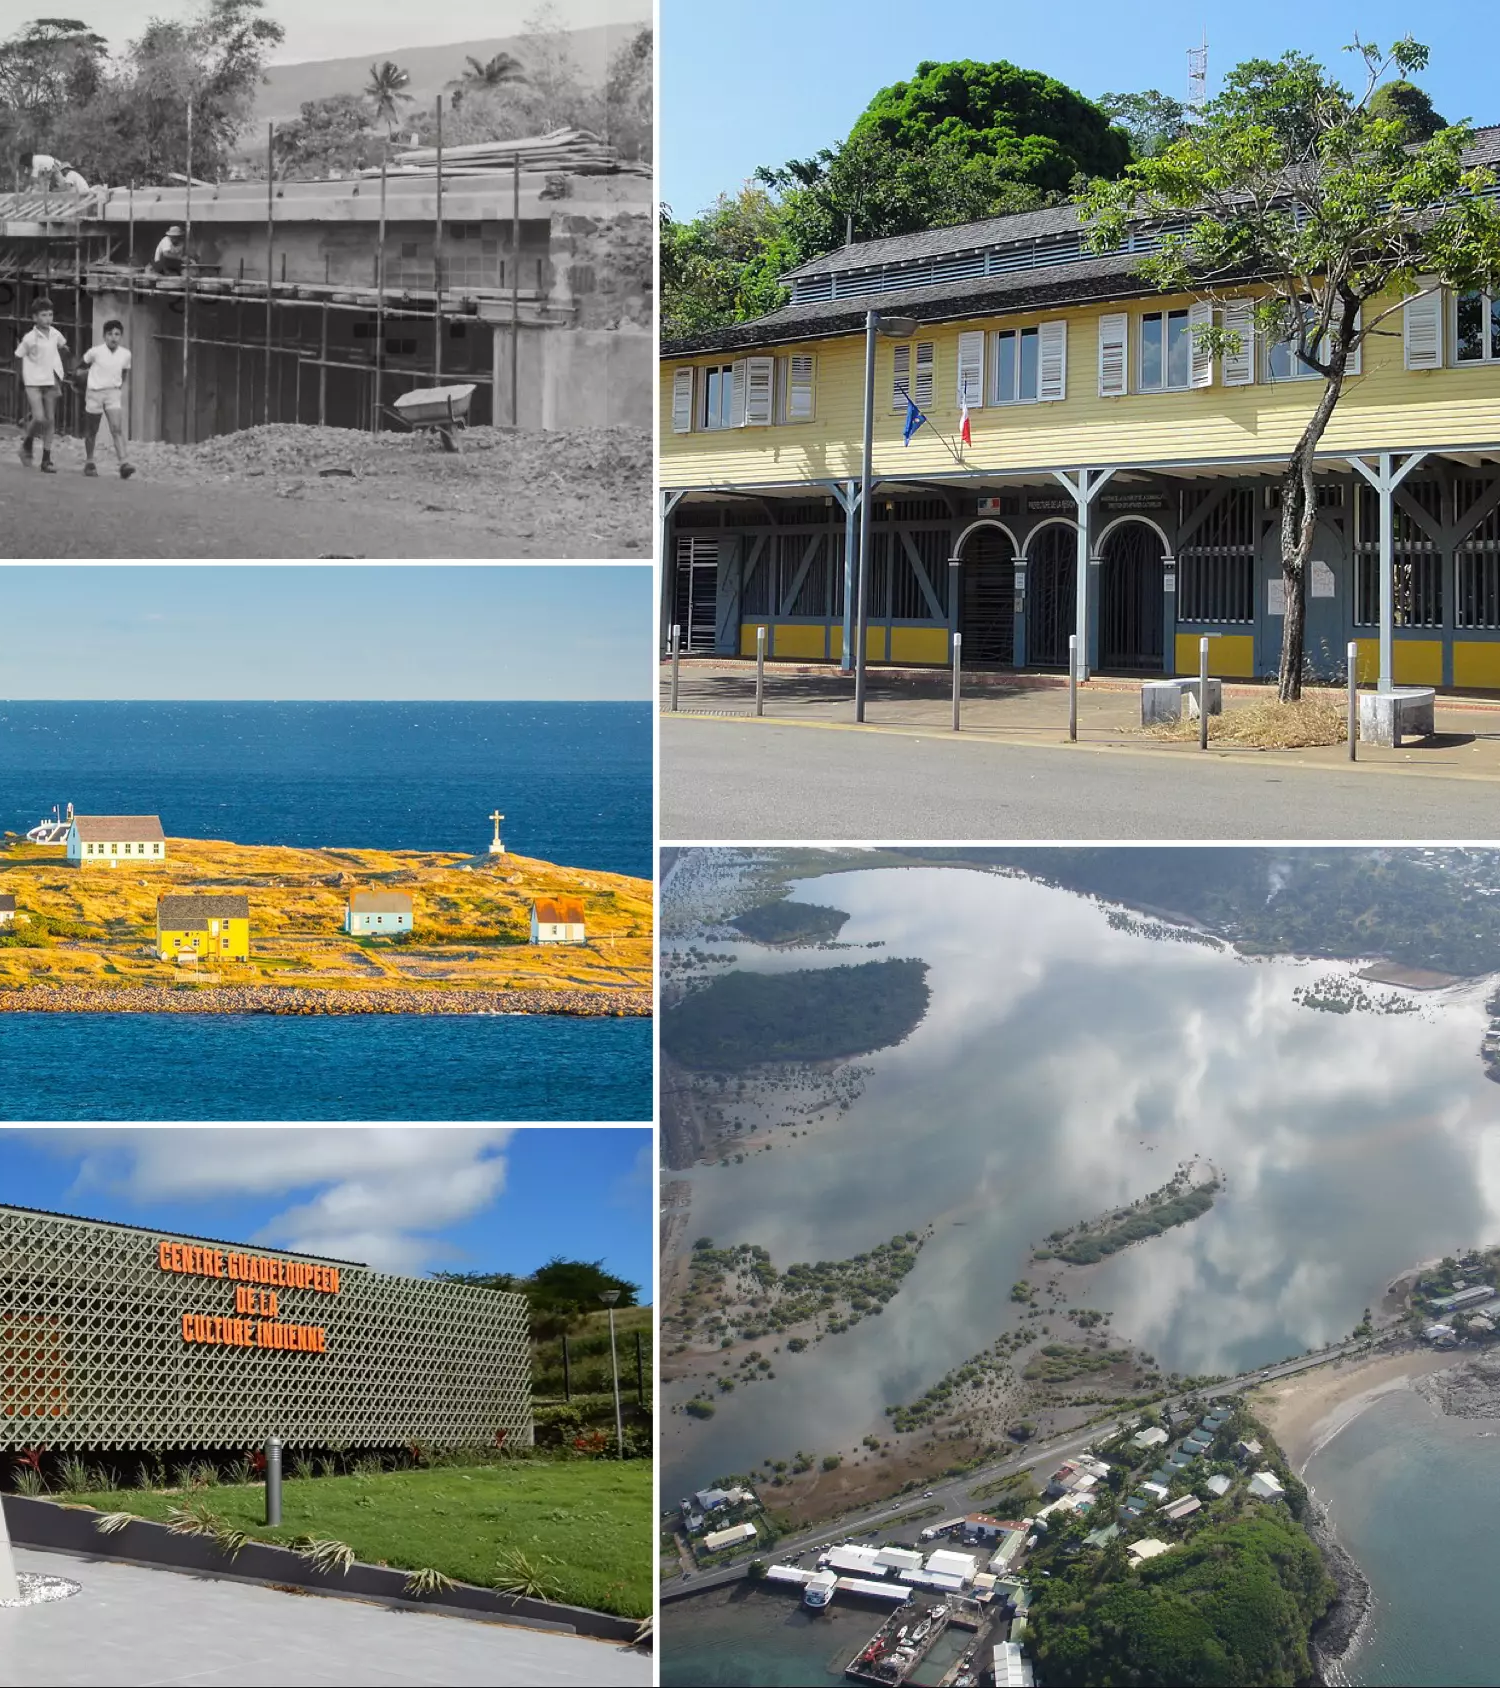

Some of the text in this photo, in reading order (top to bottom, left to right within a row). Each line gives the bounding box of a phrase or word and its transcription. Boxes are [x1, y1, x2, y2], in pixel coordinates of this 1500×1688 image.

[160, 1241, 340, 1294] CENTRE GUADELOUPEEN
[236, 1286, 278, 1317] DE LA
[182, 1313, 325, 1353] CULTURE INDIENNE
